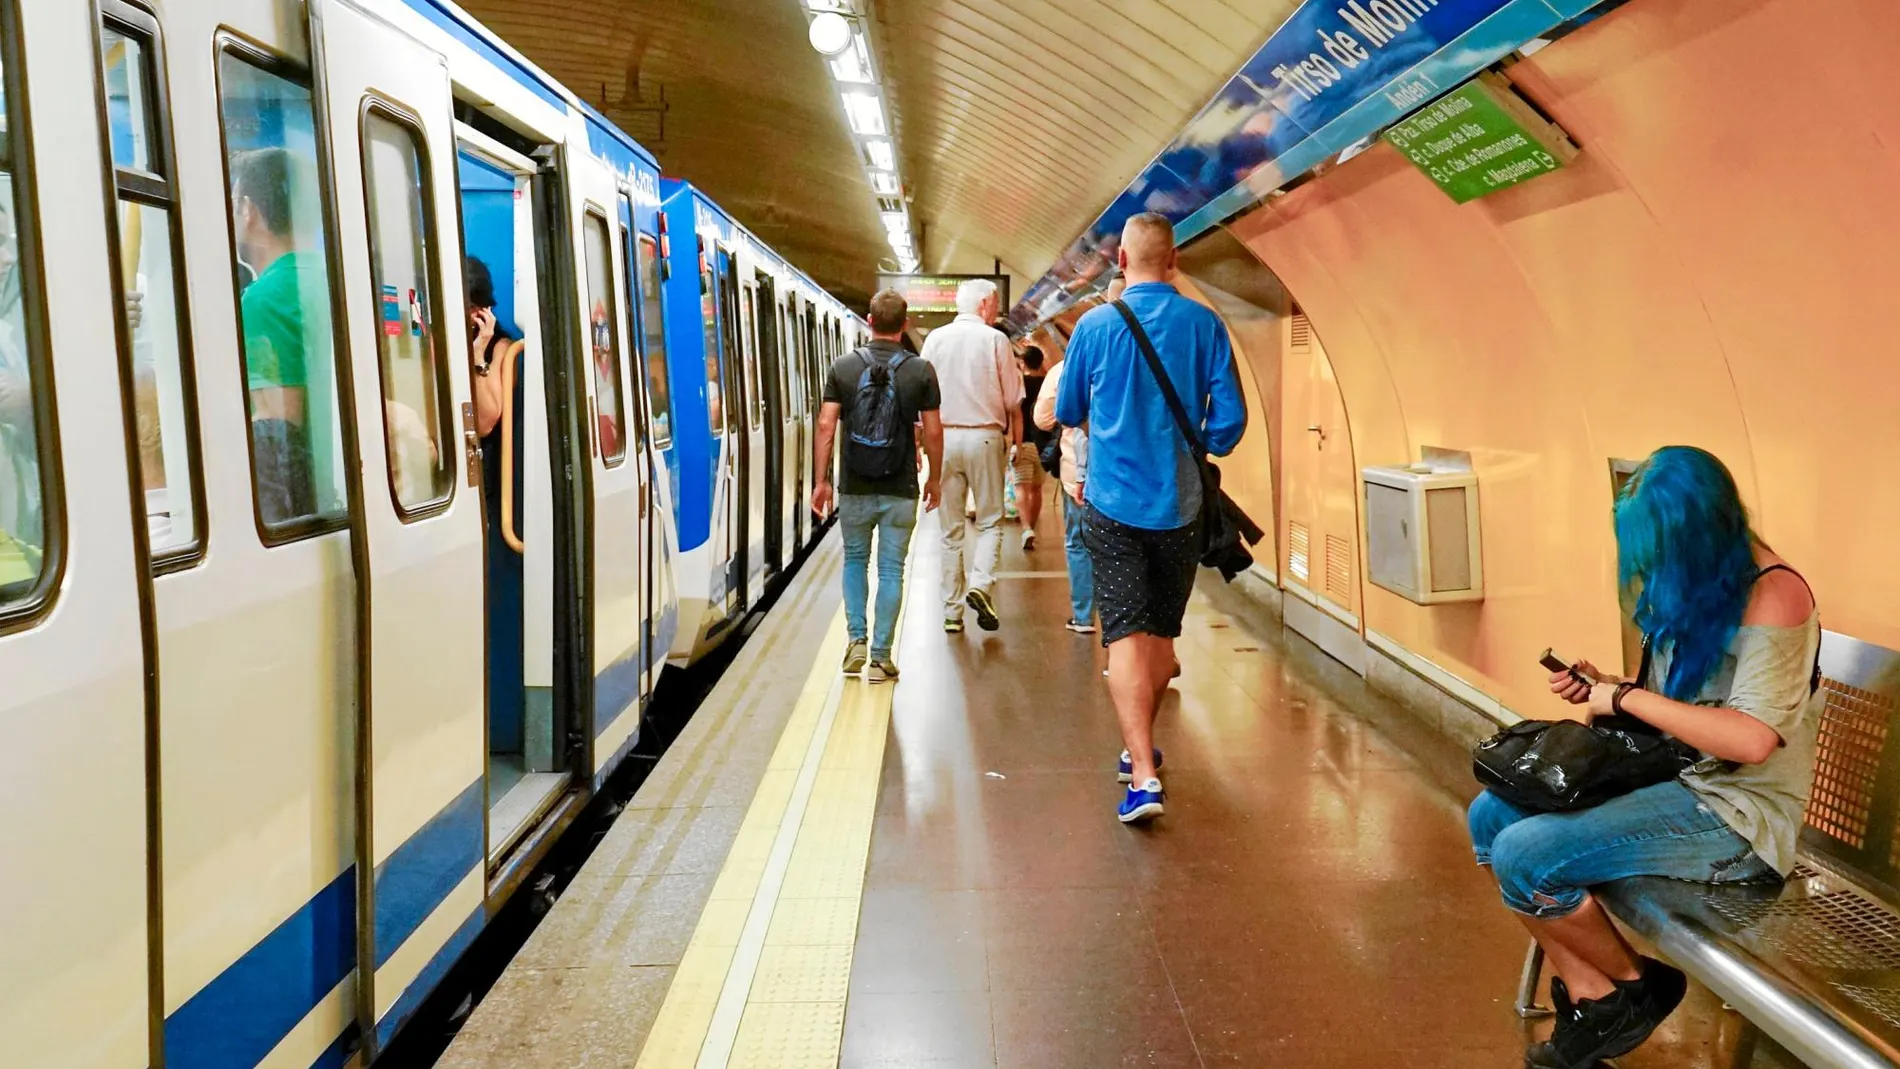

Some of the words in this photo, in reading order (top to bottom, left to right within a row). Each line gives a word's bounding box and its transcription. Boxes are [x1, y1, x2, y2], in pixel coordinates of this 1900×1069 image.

[1271, 53, 1341, 101] Tirso
[1316, 29, 1369, 69] de
[1384, 81, 1430, 110] Andén
[1419, 72, 1439, 89] 1
[1431, 109, 1448, 122] de
[1438, 96, 1473, 117] Molina
[1412, 115, 1438, 133] Tirso
[1458, 123, 1486, 141] Alba
[1425, 135, 1457, 155] Duque
[1450, 131, 1467, 145] de
[1472, 133, 1528, 162] Romanones
[1465, 152, 1481, 167] de
[1486, 158, 1540, 182] Magdalena
